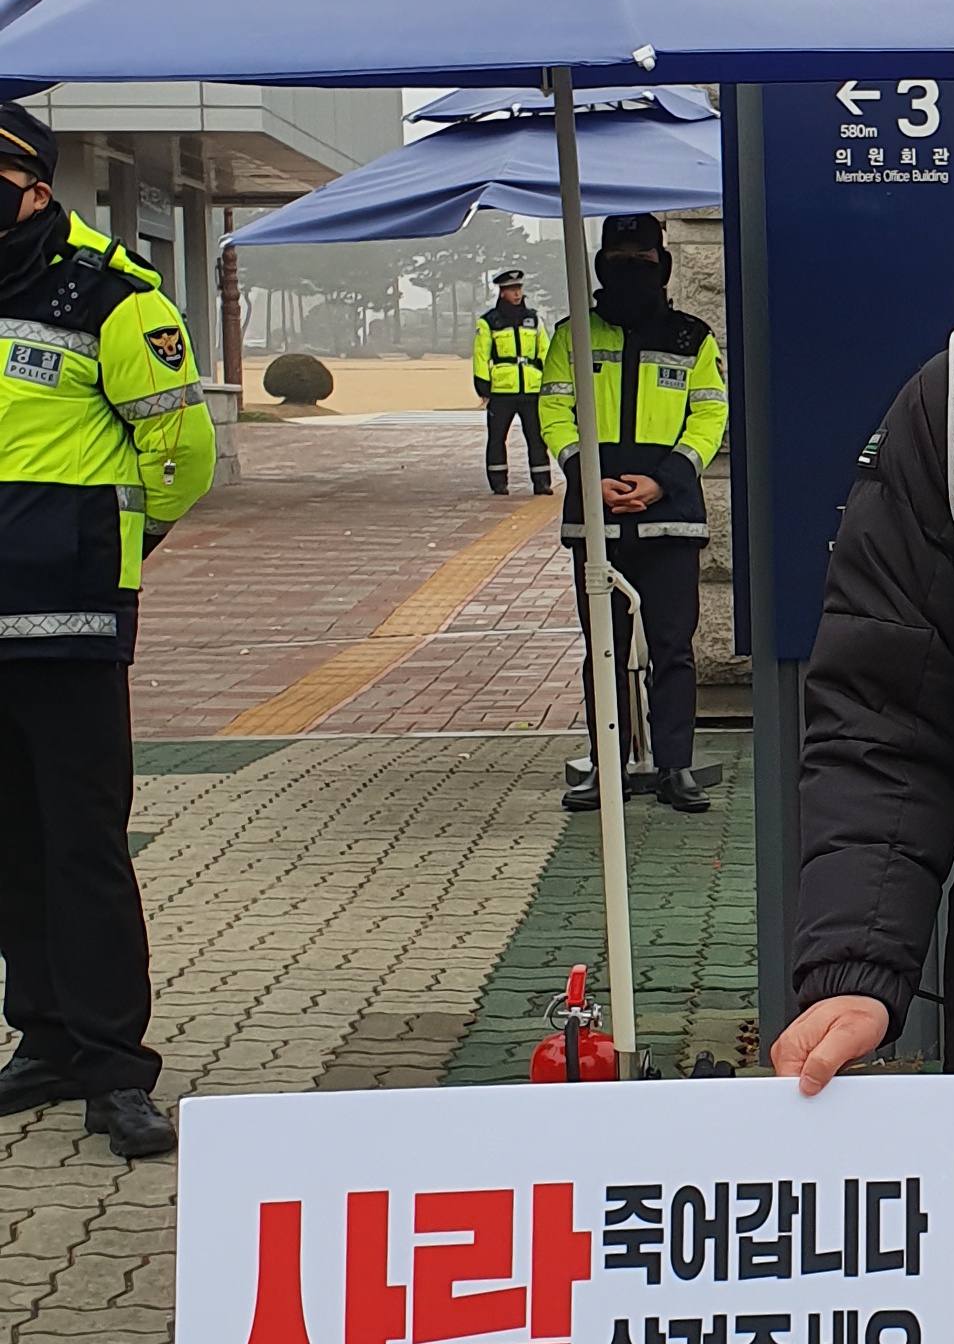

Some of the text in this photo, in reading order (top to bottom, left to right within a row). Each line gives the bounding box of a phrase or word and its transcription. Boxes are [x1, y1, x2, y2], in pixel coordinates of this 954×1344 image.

[896, 79, 940, 138] 3
[840, 124, 878, 138] 580m
[835, 147, 950, 167] 의원회관
[835, 169, 949, 184] Member's Office Building
[9, 364, 54, 382] POLICE
[602, 1177, 929, 1285] 죽어갑니다
